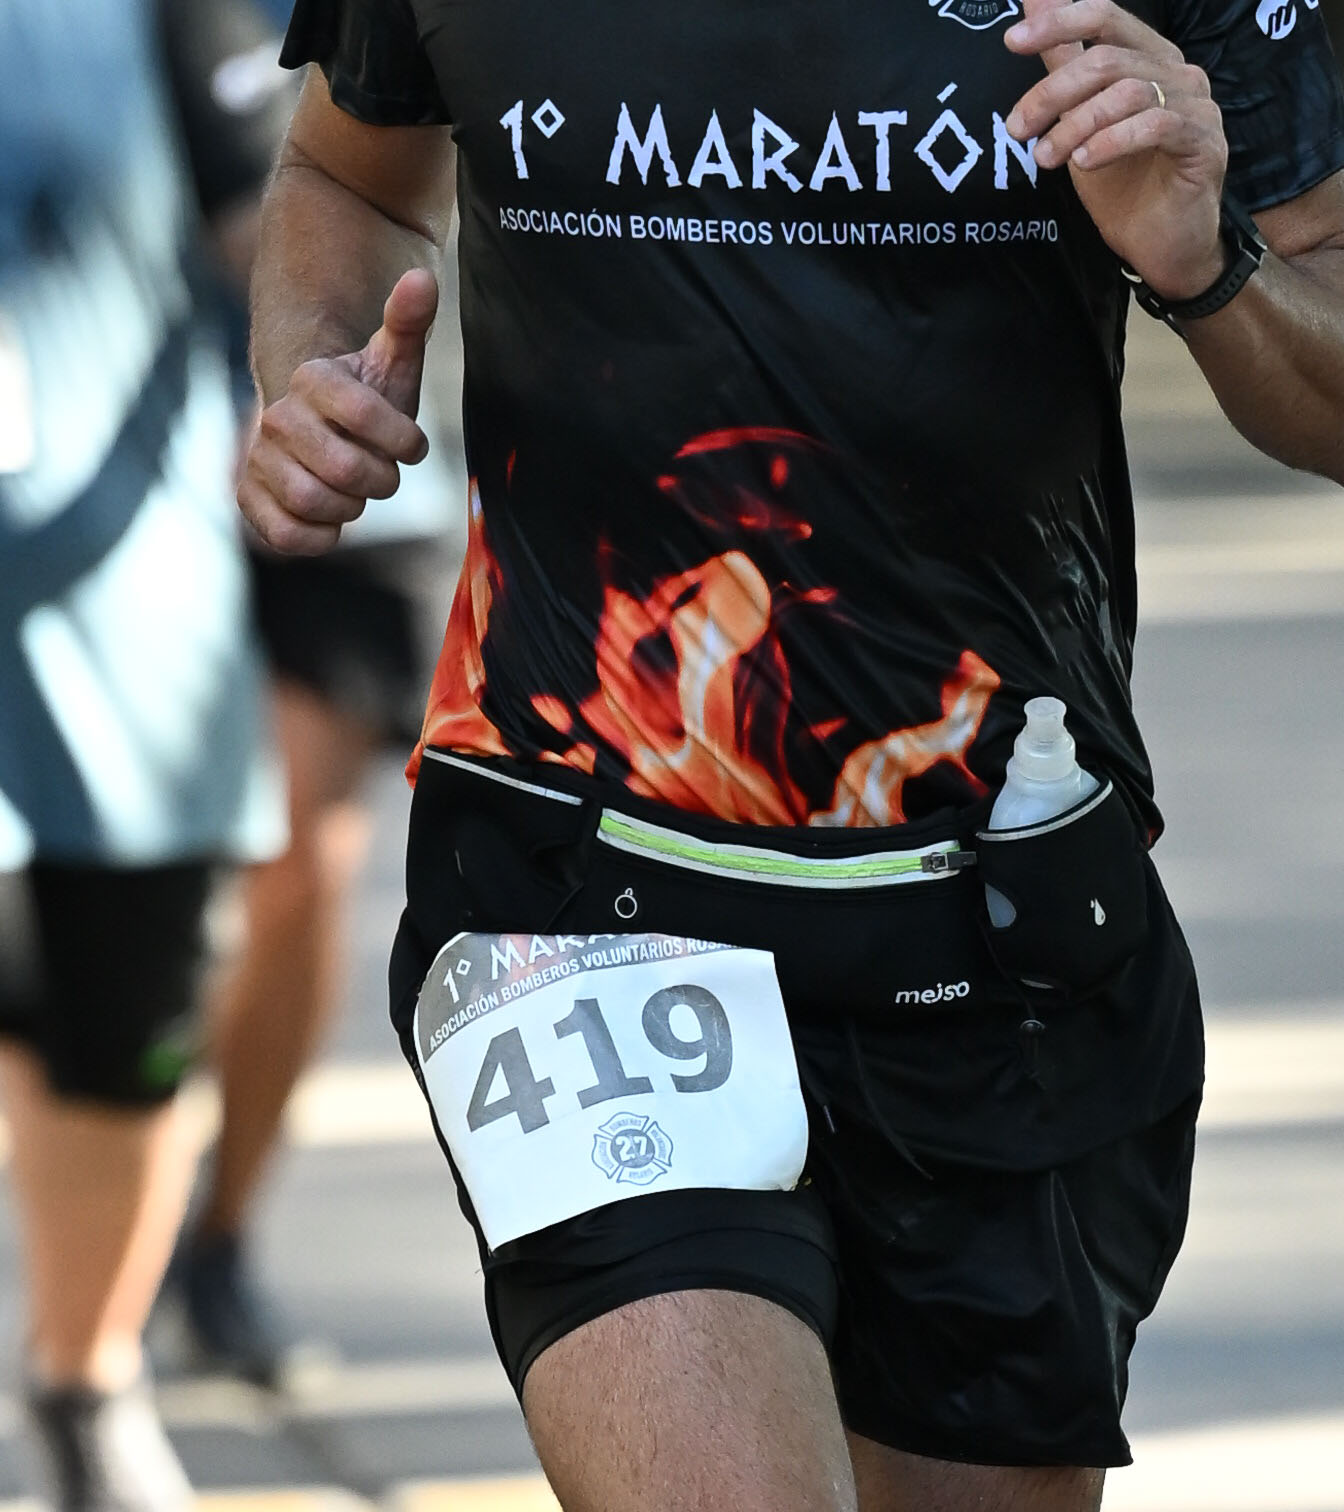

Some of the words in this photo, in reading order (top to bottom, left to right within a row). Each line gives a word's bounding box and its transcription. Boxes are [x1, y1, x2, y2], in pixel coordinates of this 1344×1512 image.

[606, 82, 1038, 194] MARATÓN
[499, 207, 622, 238] ASOCIACIÓN
[629, 215, 773, 245] BOMBEROS
[780, 220, 956, 246] VOLUNTARIOS
[965, 218, 1059, 244] ROSARIO
[429, 992, 499, 1052] ASOCIACIÓN
[500, 958, 580, 1002] BOMBEROS
[581, 937, 682, 969] VOLUNTARIOS
[466, 984, 733, 1134] 419
[615, 1135, 647, 1162] 27
